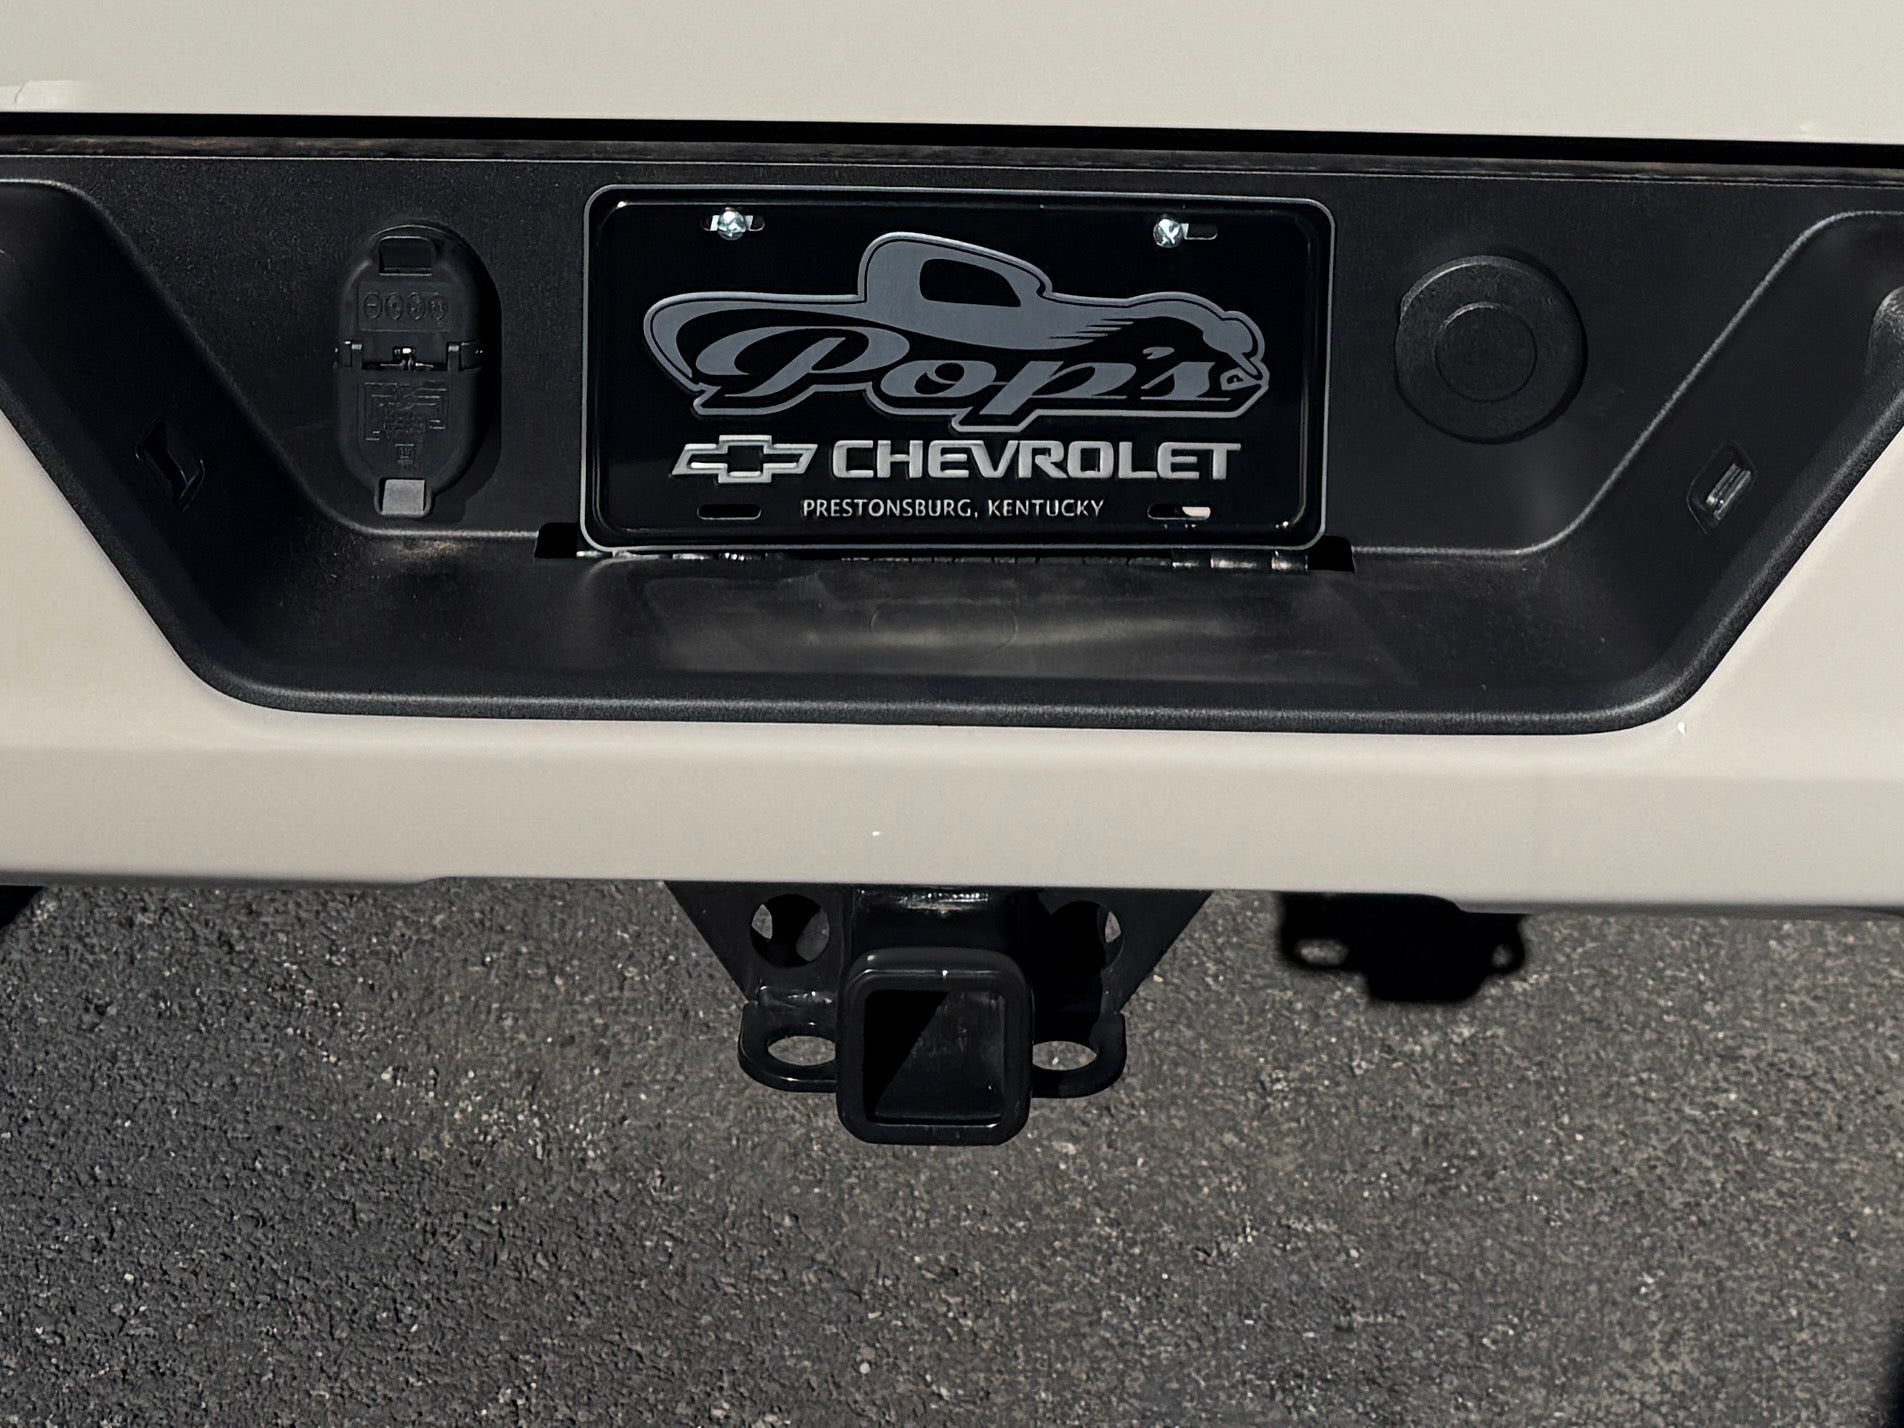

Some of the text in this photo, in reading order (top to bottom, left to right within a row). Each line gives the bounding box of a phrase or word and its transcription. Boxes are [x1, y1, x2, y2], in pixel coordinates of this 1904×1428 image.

[694, 324, 1232, 416] Pop's
[831, 439, 1243, 481] CHEVROLET
[802, 497, 1106, 523] PRESTONSBURG, KENTUCKY
